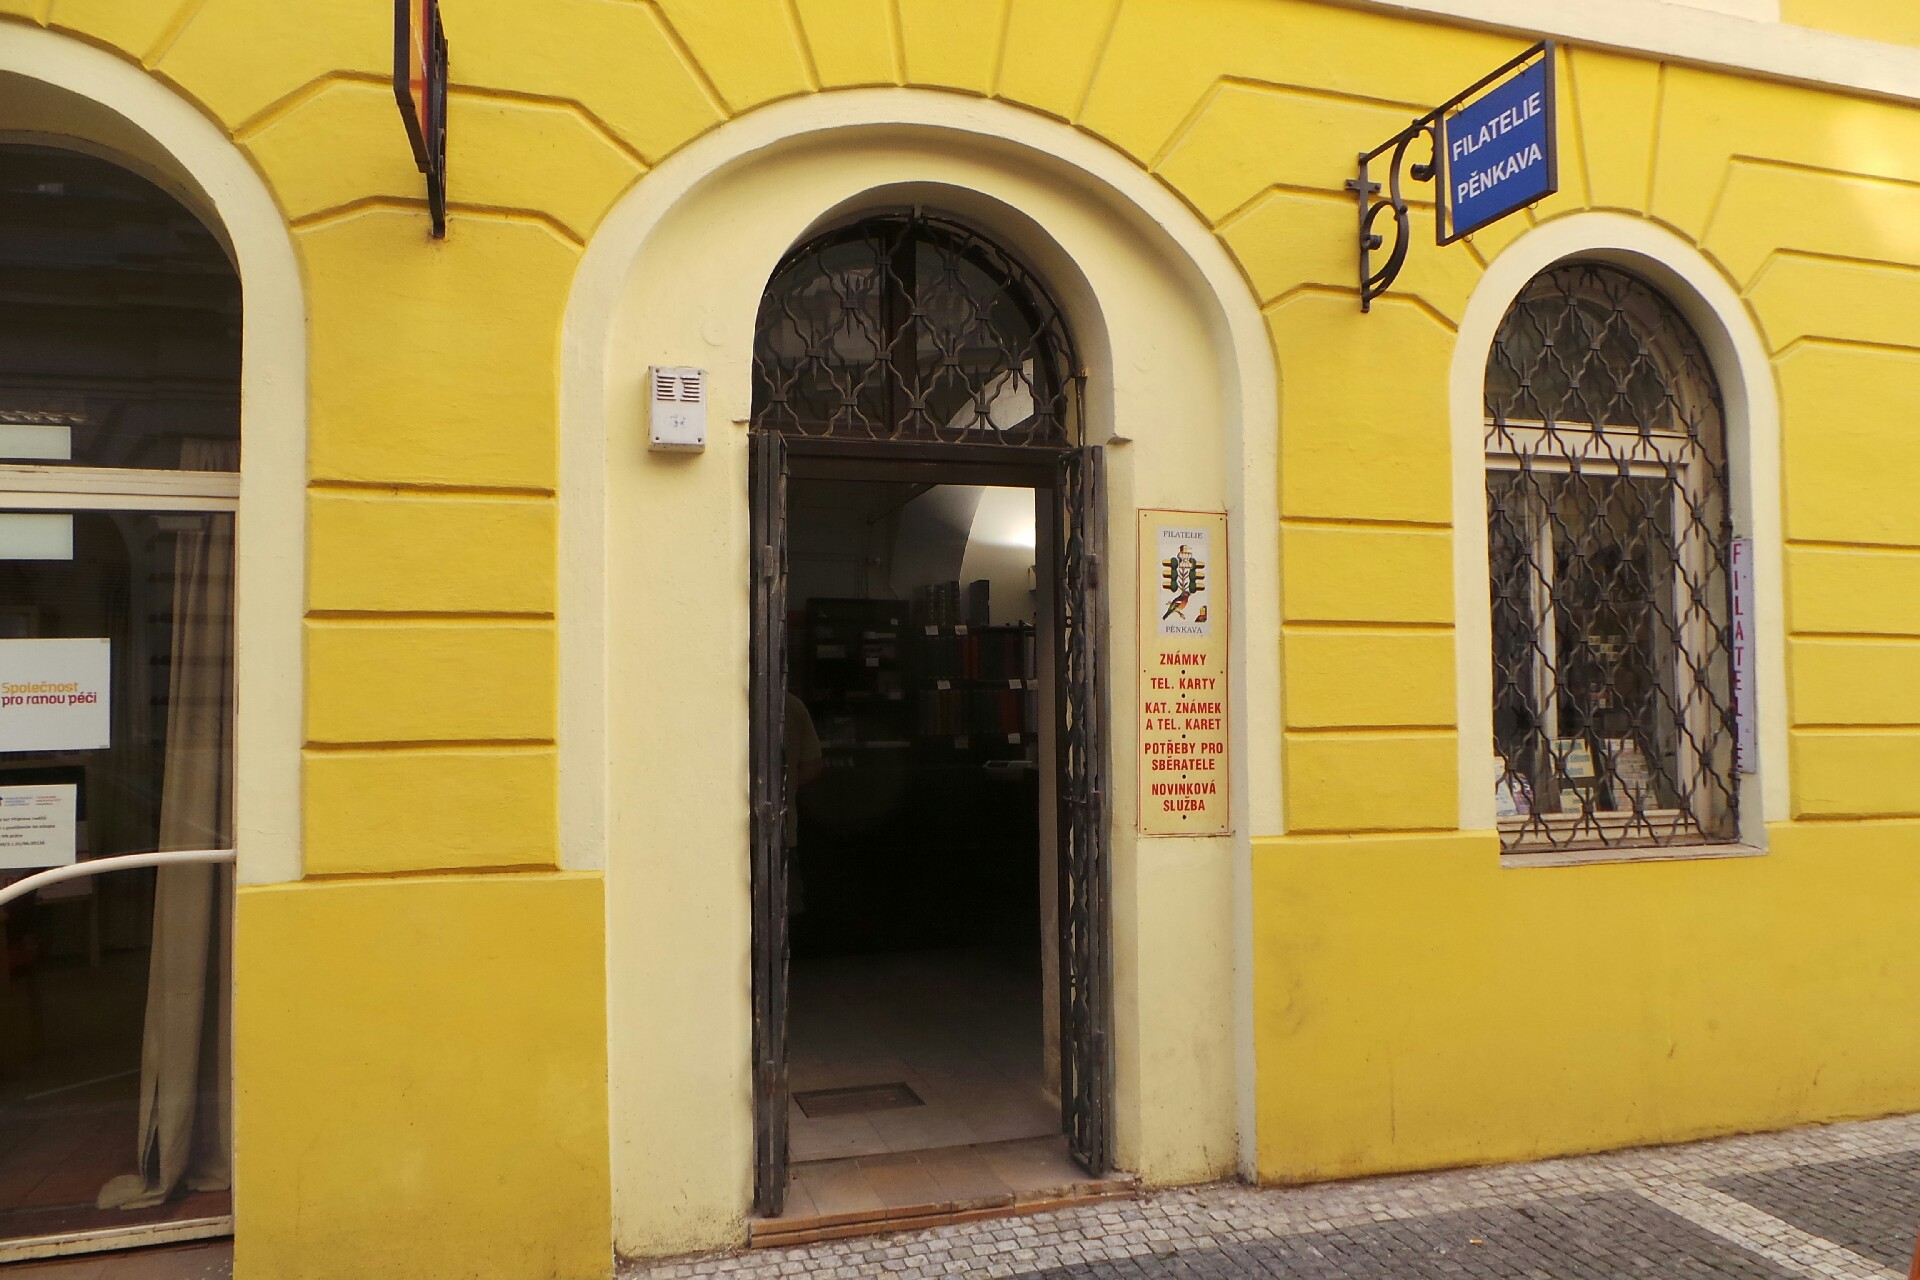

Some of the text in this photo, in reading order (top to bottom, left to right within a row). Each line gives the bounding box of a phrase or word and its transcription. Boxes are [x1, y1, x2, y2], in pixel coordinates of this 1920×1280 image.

[1453, 92, 1541, 162] FILATELIE
[1458, 143, 1542, 204] PĚNKAVA
[1163, 530, 1203, 540] FILATELIE
[1160, 650, 1207, 666] ZNÁMKY
[1, 681, 79, 696] Společnost
[1151, 677, 1216, 690] TEL. KARTY
[1, 691, 97, 708] pro ranou péči
[1145, 699, 1222, 714] KAT. ZNÁMEK
[1146, 718, 1221, 731] A TEL. KARET
[1144, 739, 1224, 755] POTŘEBY PRO
[1152, 755, 1215, 771] SBĚRATELE
[1151, 779, 1216, 796] NOVINKOVÁ
[1163, 796, 1206, 812] SLUŽBA
